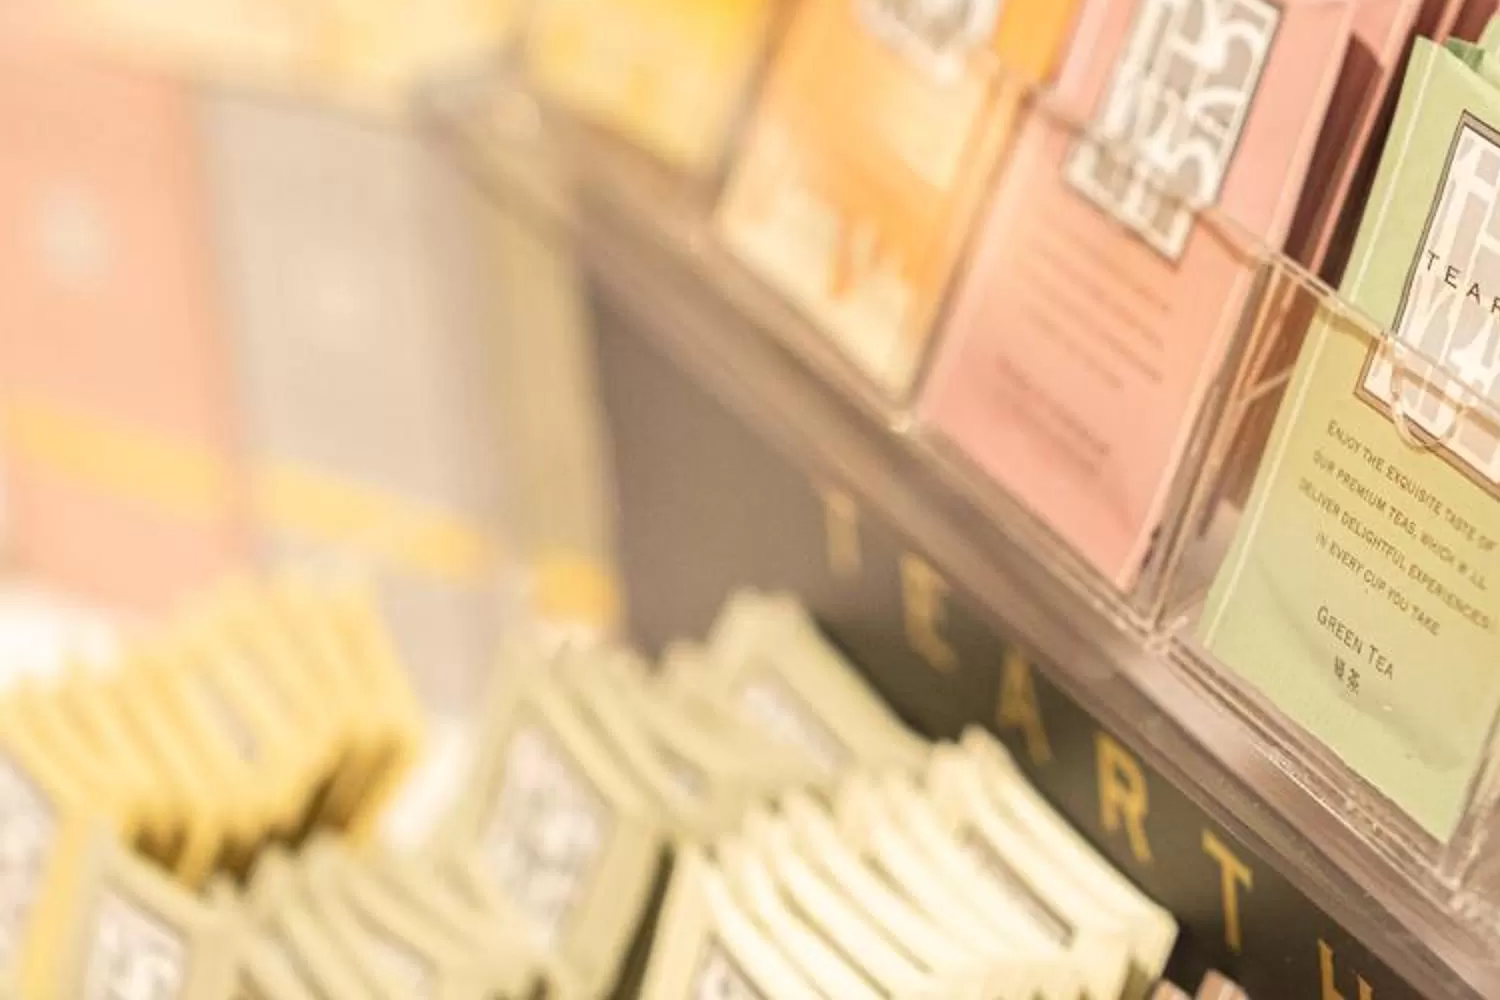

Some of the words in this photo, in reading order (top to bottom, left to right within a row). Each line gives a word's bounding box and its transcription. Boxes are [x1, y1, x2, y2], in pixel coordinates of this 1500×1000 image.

[1328, 420, 1360, 454] ENJOY
[1363, 448, 1384, 472] THE
[1386, 467, 1441, 516] EXQUISITE
[1336, 467, 1386, 512] PREMIUM
[1299, 476, 1340, 516] DELIVER
[1341, 511, 1406, 571] DELIGHTFUL
[1330, 540, 1364, 575] EVERY
[1363, 568, 1386, 593] CUP
[1387, 587, 1408, 613] YOU
[1317, 604, 1363, 655] GREEN
[1368, 644, 1394, 681] TEA
